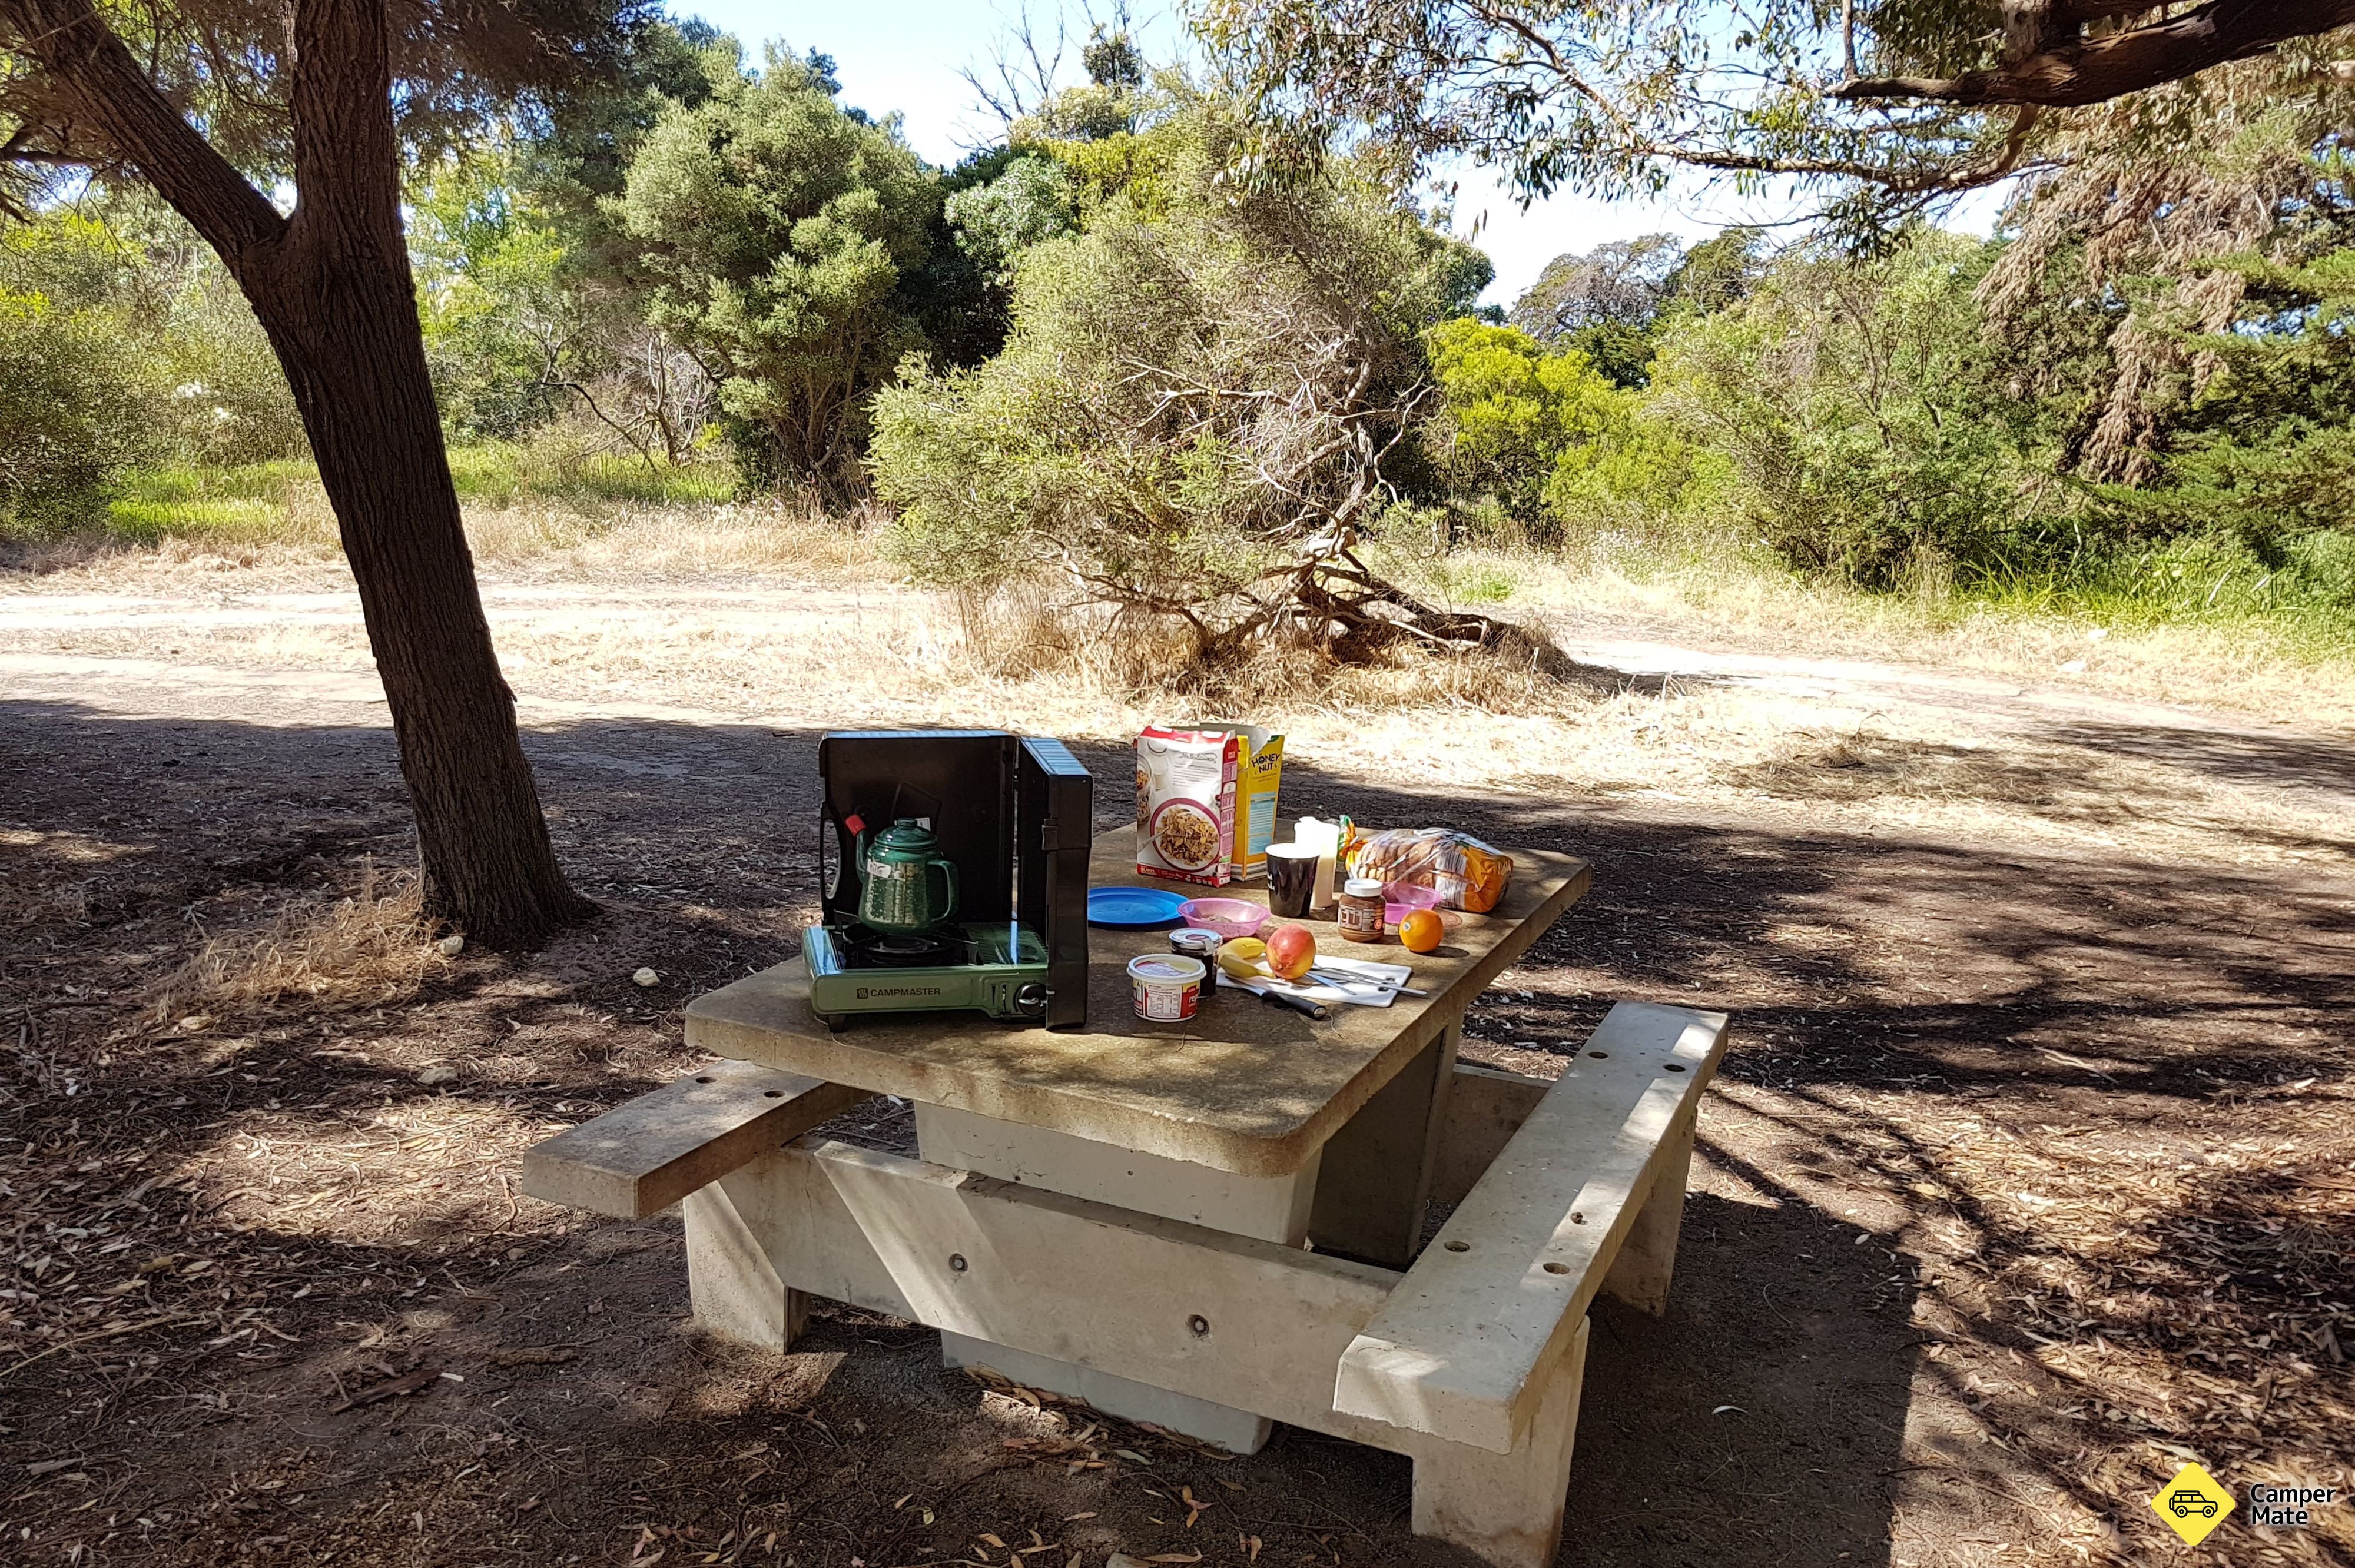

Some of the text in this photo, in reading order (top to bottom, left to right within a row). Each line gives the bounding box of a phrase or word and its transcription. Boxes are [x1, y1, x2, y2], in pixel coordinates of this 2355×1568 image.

[1252, 753, 1281, 768] HONEY
[1259, 762, 1273, 773] NUT
[871, 988, 941, 996] CAMPMASTER
